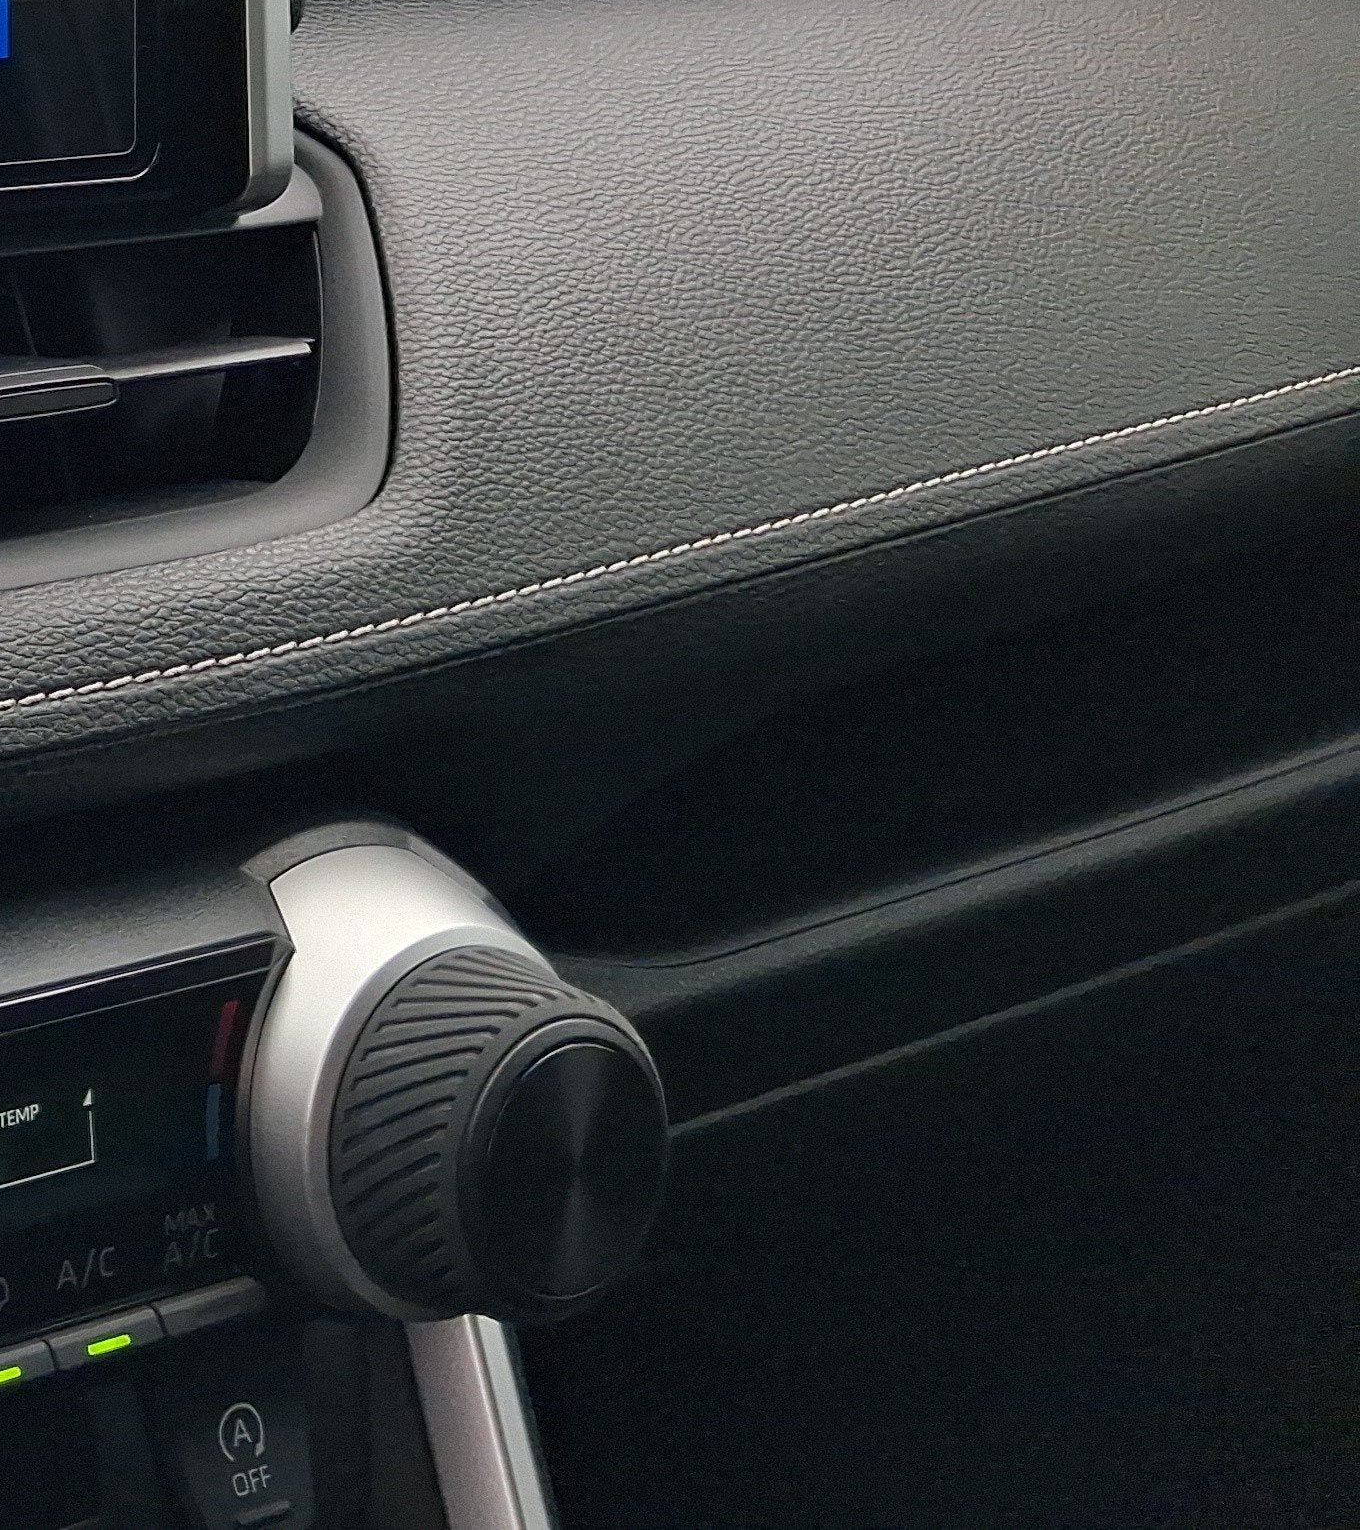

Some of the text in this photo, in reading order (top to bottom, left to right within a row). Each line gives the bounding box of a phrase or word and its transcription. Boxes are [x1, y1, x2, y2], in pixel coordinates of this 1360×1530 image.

[163, 1202, 217, 1236] MAX
[56, 1245, 116, 1291] A/C
[162, 1227, 220, 1273] A/C
[232, 1463, 272, 1497] OFF
